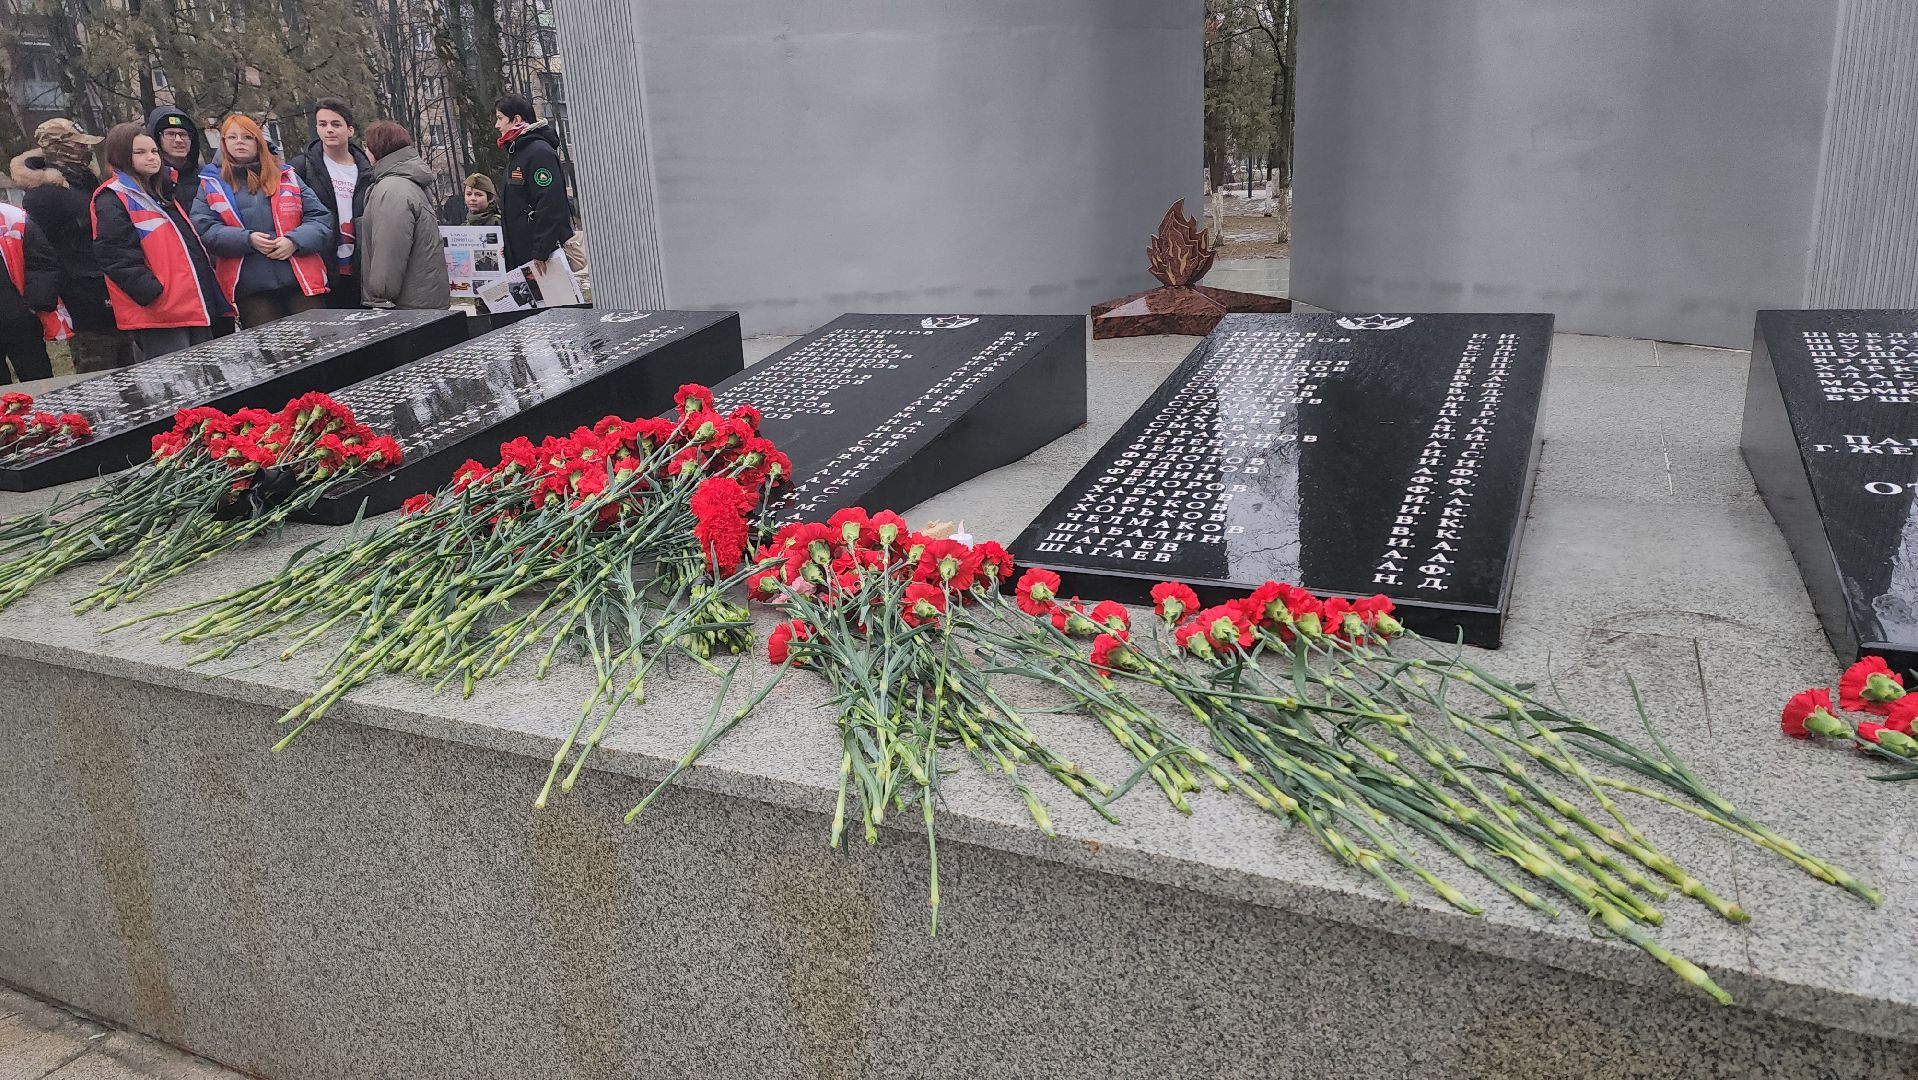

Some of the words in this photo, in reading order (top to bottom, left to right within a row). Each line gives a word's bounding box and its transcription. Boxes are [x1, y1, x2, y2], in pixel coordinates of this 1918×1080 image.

[1197, 370, 1328, 378] СМИРНОВ
[1202, 364, 1346, 372] СВИРИДОВ
[728, 386, 829, 395] МОРОЗОВ
[1186, 382, 1318, 390] СОКОЛОВ
[1191, 376, 1307, 384] СМОЛИН
[1173, 394, 1323, 404] СОЛОВЬЕВ
[1180, 388, 1313, 397] СОКОЛОВ
[1155, 415, 1281, 425] СУХАРЕВ
[1161, 408, 1286, 418] СУХАРЕВ
[1148, 422, 1245, 431] СЫЧЕВ
[1136, 436, 1273, 449] ТЕРЕНИН
[1421, 449, 1447, 457] И.
[1143, 429, 1318, 443] ТАРАКАНОВ
[1425, 440, 1447, 448] А.
[1121, 452, 1265, 465] ФЕДОТОВ
[1450, 469, 1478, 477] Ф.
[1129, 444, 1228, 455] ФЕДИН
[1418, 458, 1444, 466] И.
[1106, 468, 1215, 481] ФЕНИН
[1406, 485, 1435, 494] Ф.
[1448, 488, 1473, 496] А.
[1113, 460, 1260, 474] ФЕДОТОВ
[1410, 476, 1439, 484] Ф.
[1447, 478, 1475, 487] Ф.
[1088, 484, 1234, 501] ХАБАРОВ
[1399, 505, 1426, 515] И.
[1441, 507, 1467, 517] К.
[1098, 476, 1248, 493] ФЁДОРОВ
[1403, 495, 1430, 504] И.
[1446, 498, 1470, 506] А.
[1072, 502, 1226, 522] ХОРЬКОВ
[1391, 527, 1415, 536] В.
[1435, 529, 1461, 540] К.
[1080, 493, 1229, 512] ХАРЬКОВ
[1394, 515, 1418, 525] В.
[1438, 518, 1464, 528] К.
[1053, 522, 1224, 543] ШАБАЛИН
[1381, 549, 1408, 559] А.
[1427, 553, 1455, 563] А.
[1066, 513, 1245, 534] ЧЕЛМАКОВ
[1385, 538, 1415, 548] И.
[1430, 541, 1458, 551] А.
[1044, 532, 1180, 552] ШАГАЕВ
[1376, 561, 1404, 571] А.
[1419, 565, 1451, 575] Ф.
[1035, 542, 1172, 562] ШАГАЕВ
[1372, 574, 1403, 585] Н.
[1417, 578, 1448, 590] Д.
